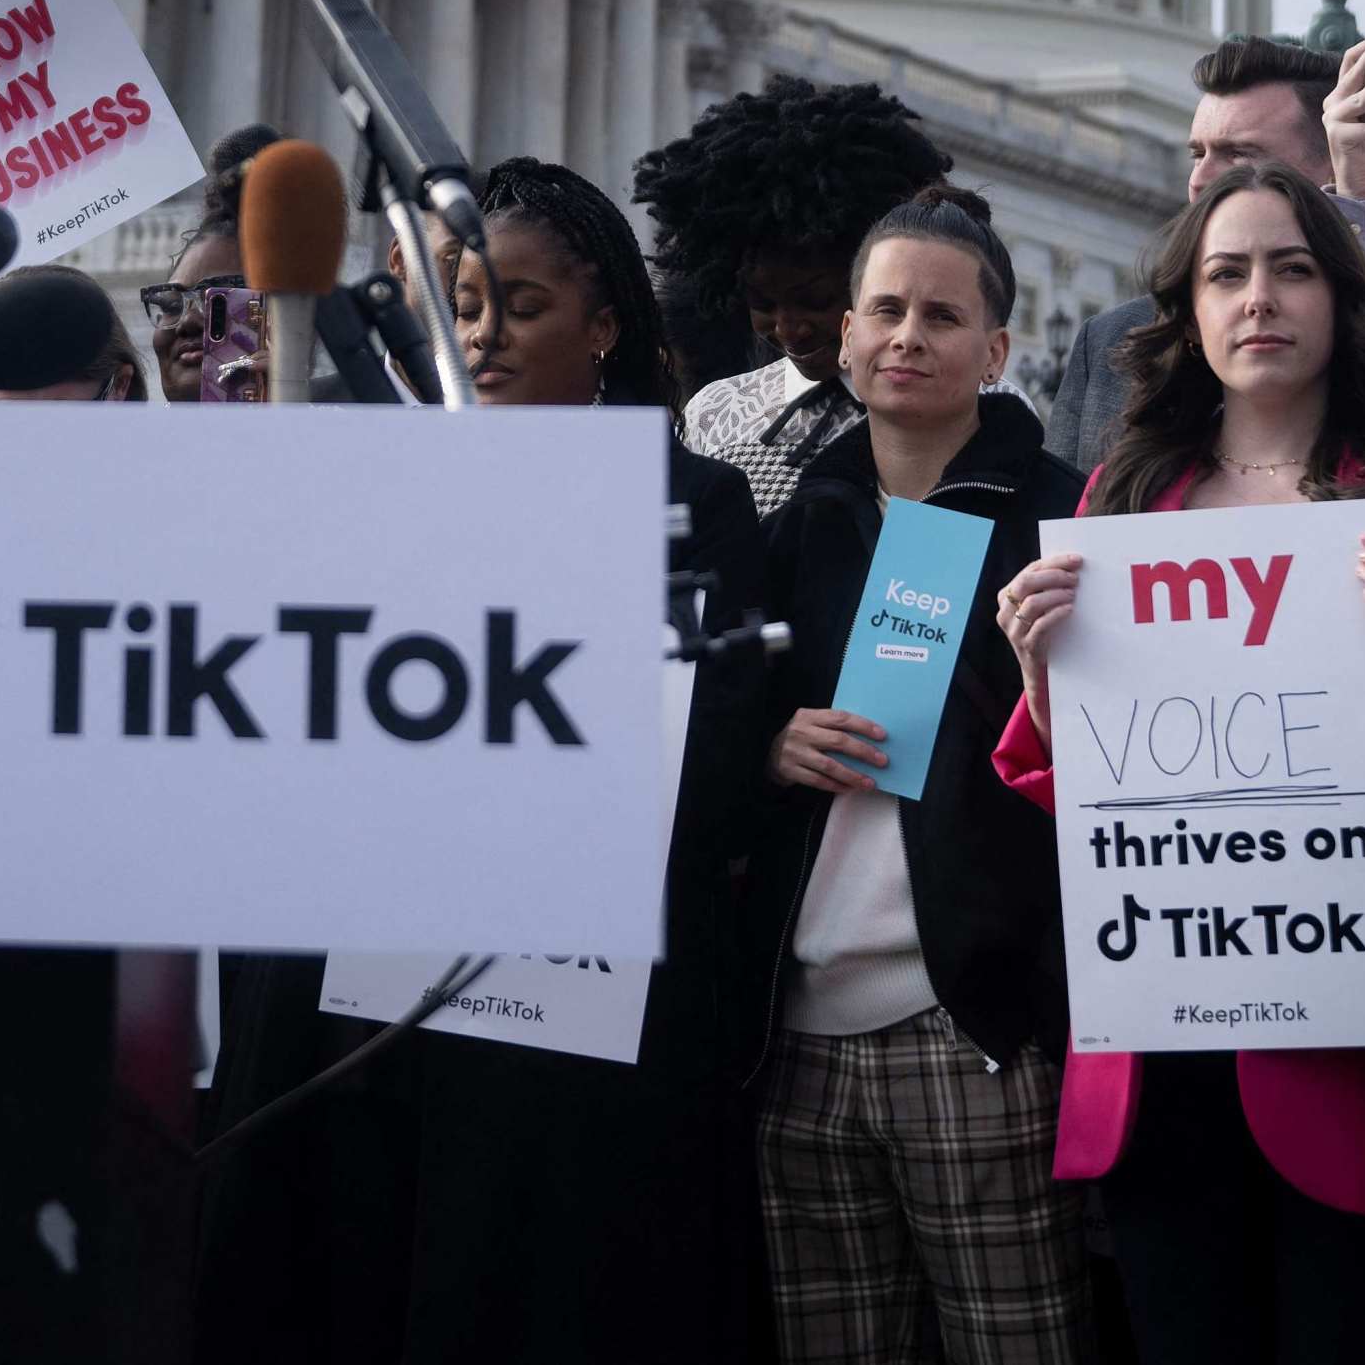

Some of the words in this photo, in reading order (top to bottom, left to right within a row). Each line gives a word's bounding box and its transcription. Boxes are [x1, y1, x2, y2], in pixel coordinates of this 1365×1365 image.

[37, 187, 131, 244] #KeepTikTok
[885, 578, 951, 619] Keep
[1130, 554, 1294, 646] my
[879, 646, 902, 657] Learn
[904, 649, 925, 658] more
[890, 616, 948, 645] TikTok
[23, 602, 589, 747] TikTok
[1080, 690, 1332, 785] VOICE
[1090, 818, 1287, 868] thrives
[1173, 1002, 1309, 1027] #KeepTikTok
